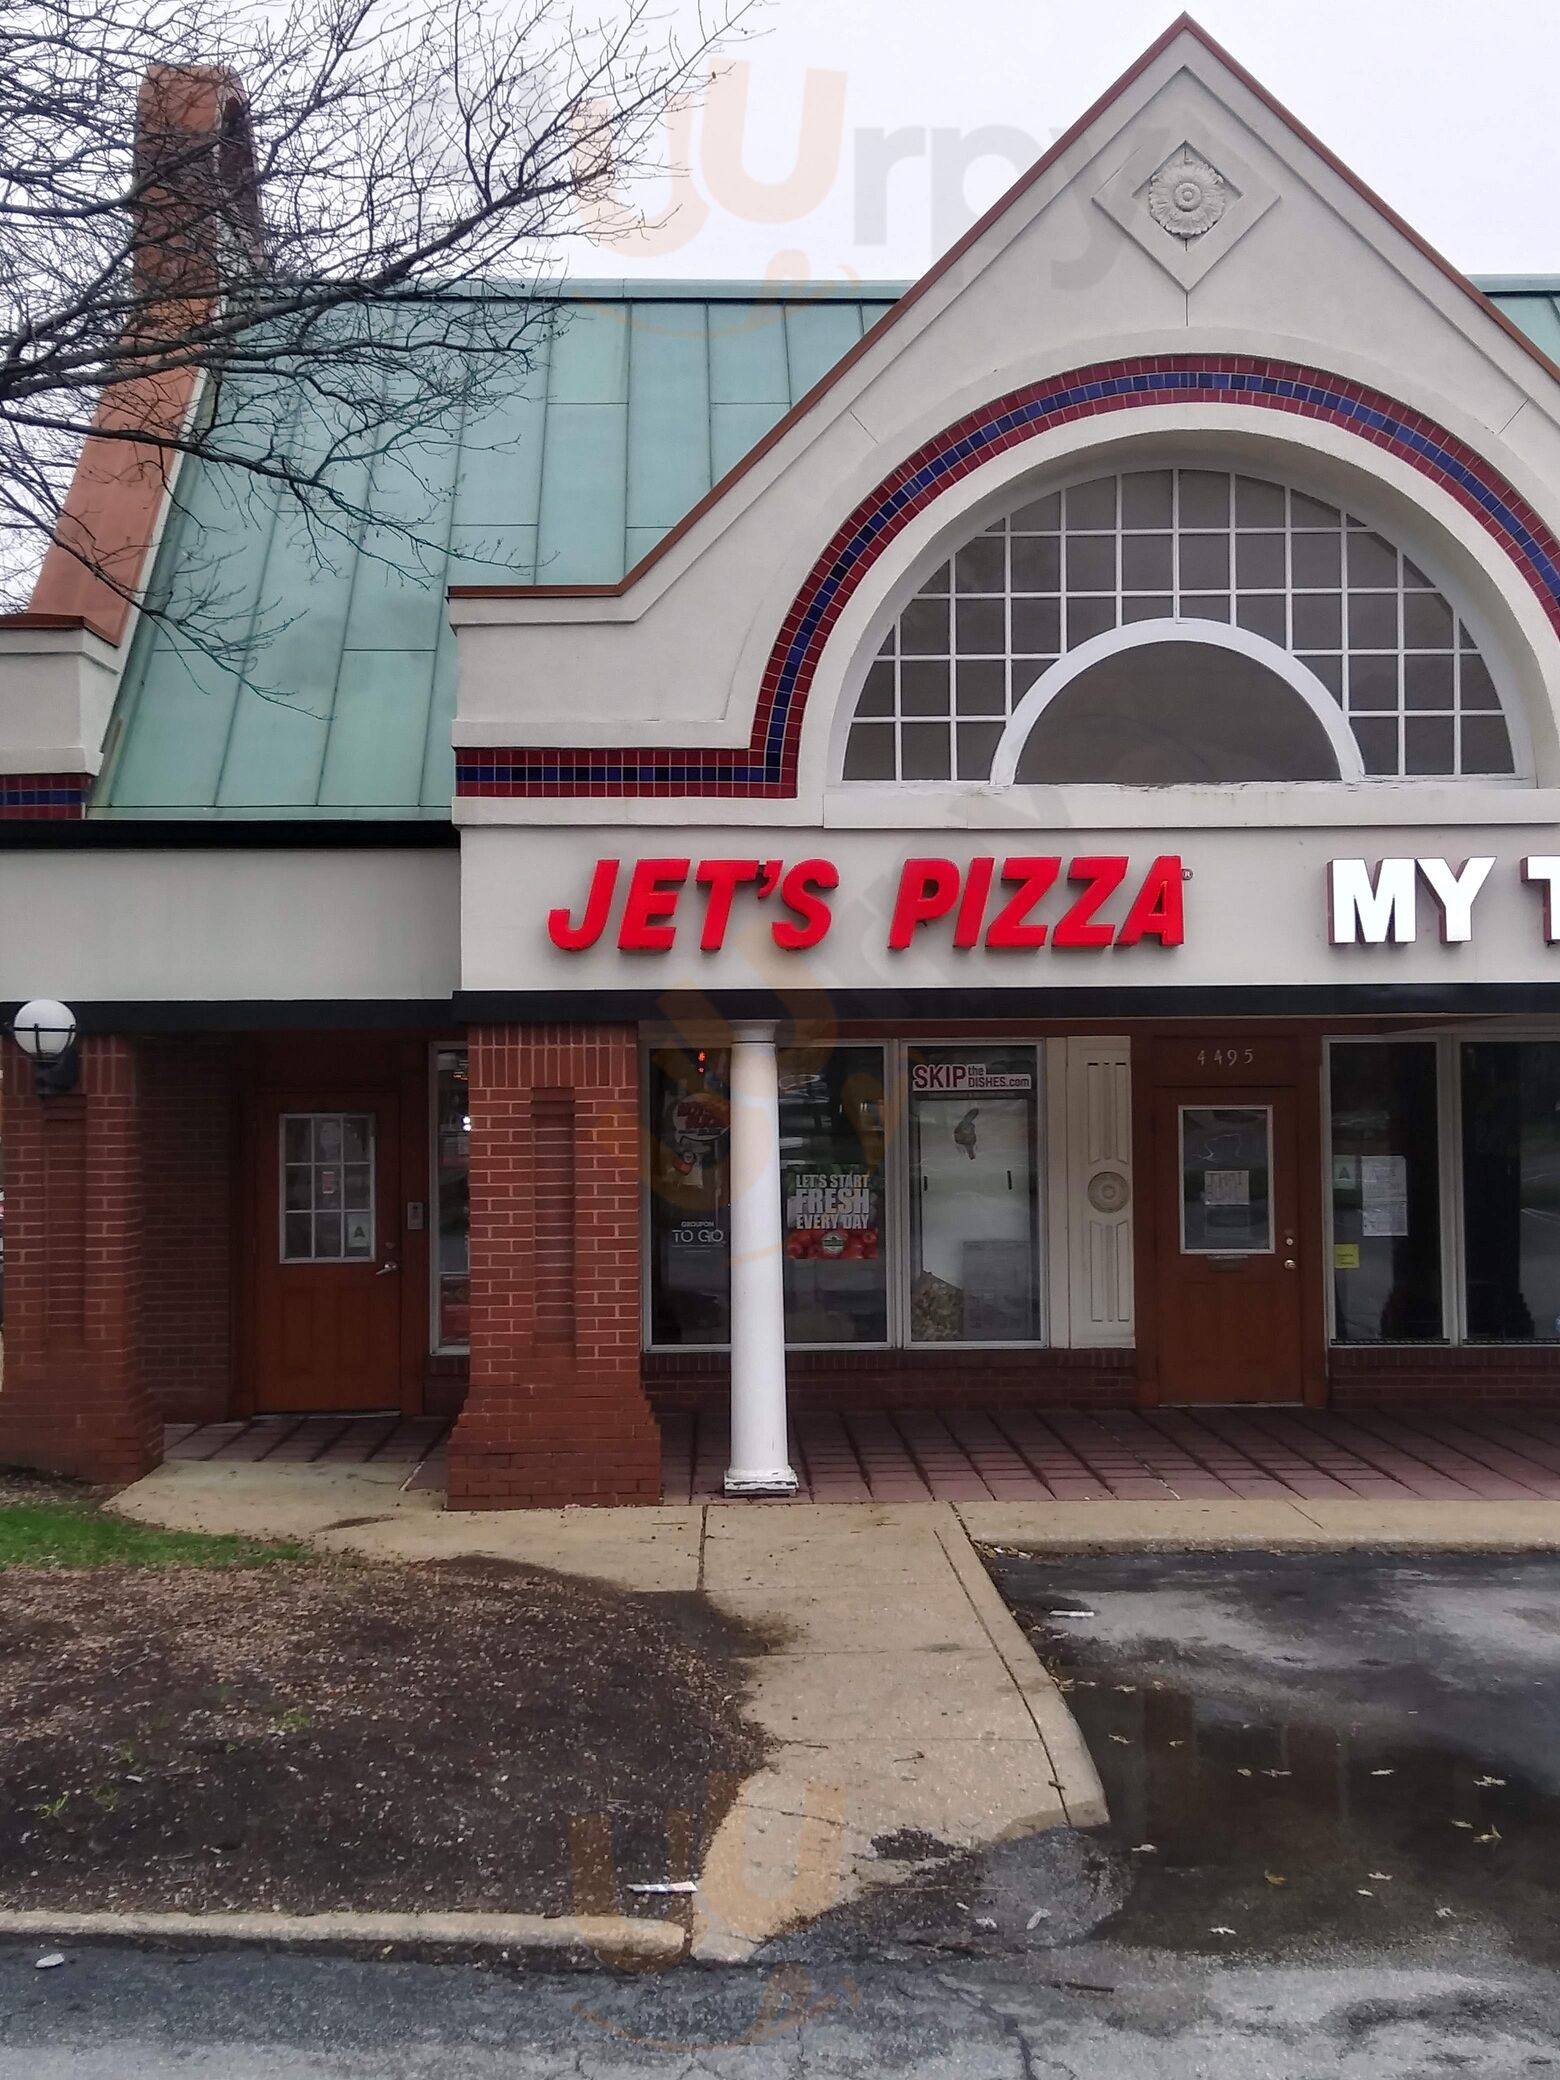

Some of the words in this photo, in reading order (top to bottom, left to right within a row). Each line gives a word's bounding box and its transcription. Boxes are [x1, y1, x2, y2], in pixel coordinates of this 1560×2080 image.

[548, 858, 838, 952] JET'S
[889, 854, 1183, 950] PIZZA
[1328, 857, 1497, 945] MY
[1196, 1048, 1255, 1067] 4495
[913, 1065, 967, 1089] SKIP
[968, 1066, 984, 1076] the
[968, 1076, 1030, 1088] DISHES.com
[795, 1174, 828, 1188] LET'S
[829, 1173, 870, 1188] START
[795, 1188, 870, 1214] FRESH
[796, 1214, 838, 1230] EVERY
[841, 1214, 870, 1230] DAY
[672, 1229, 694, 1243] TO
[698, 1229, 725, 1243] GO
